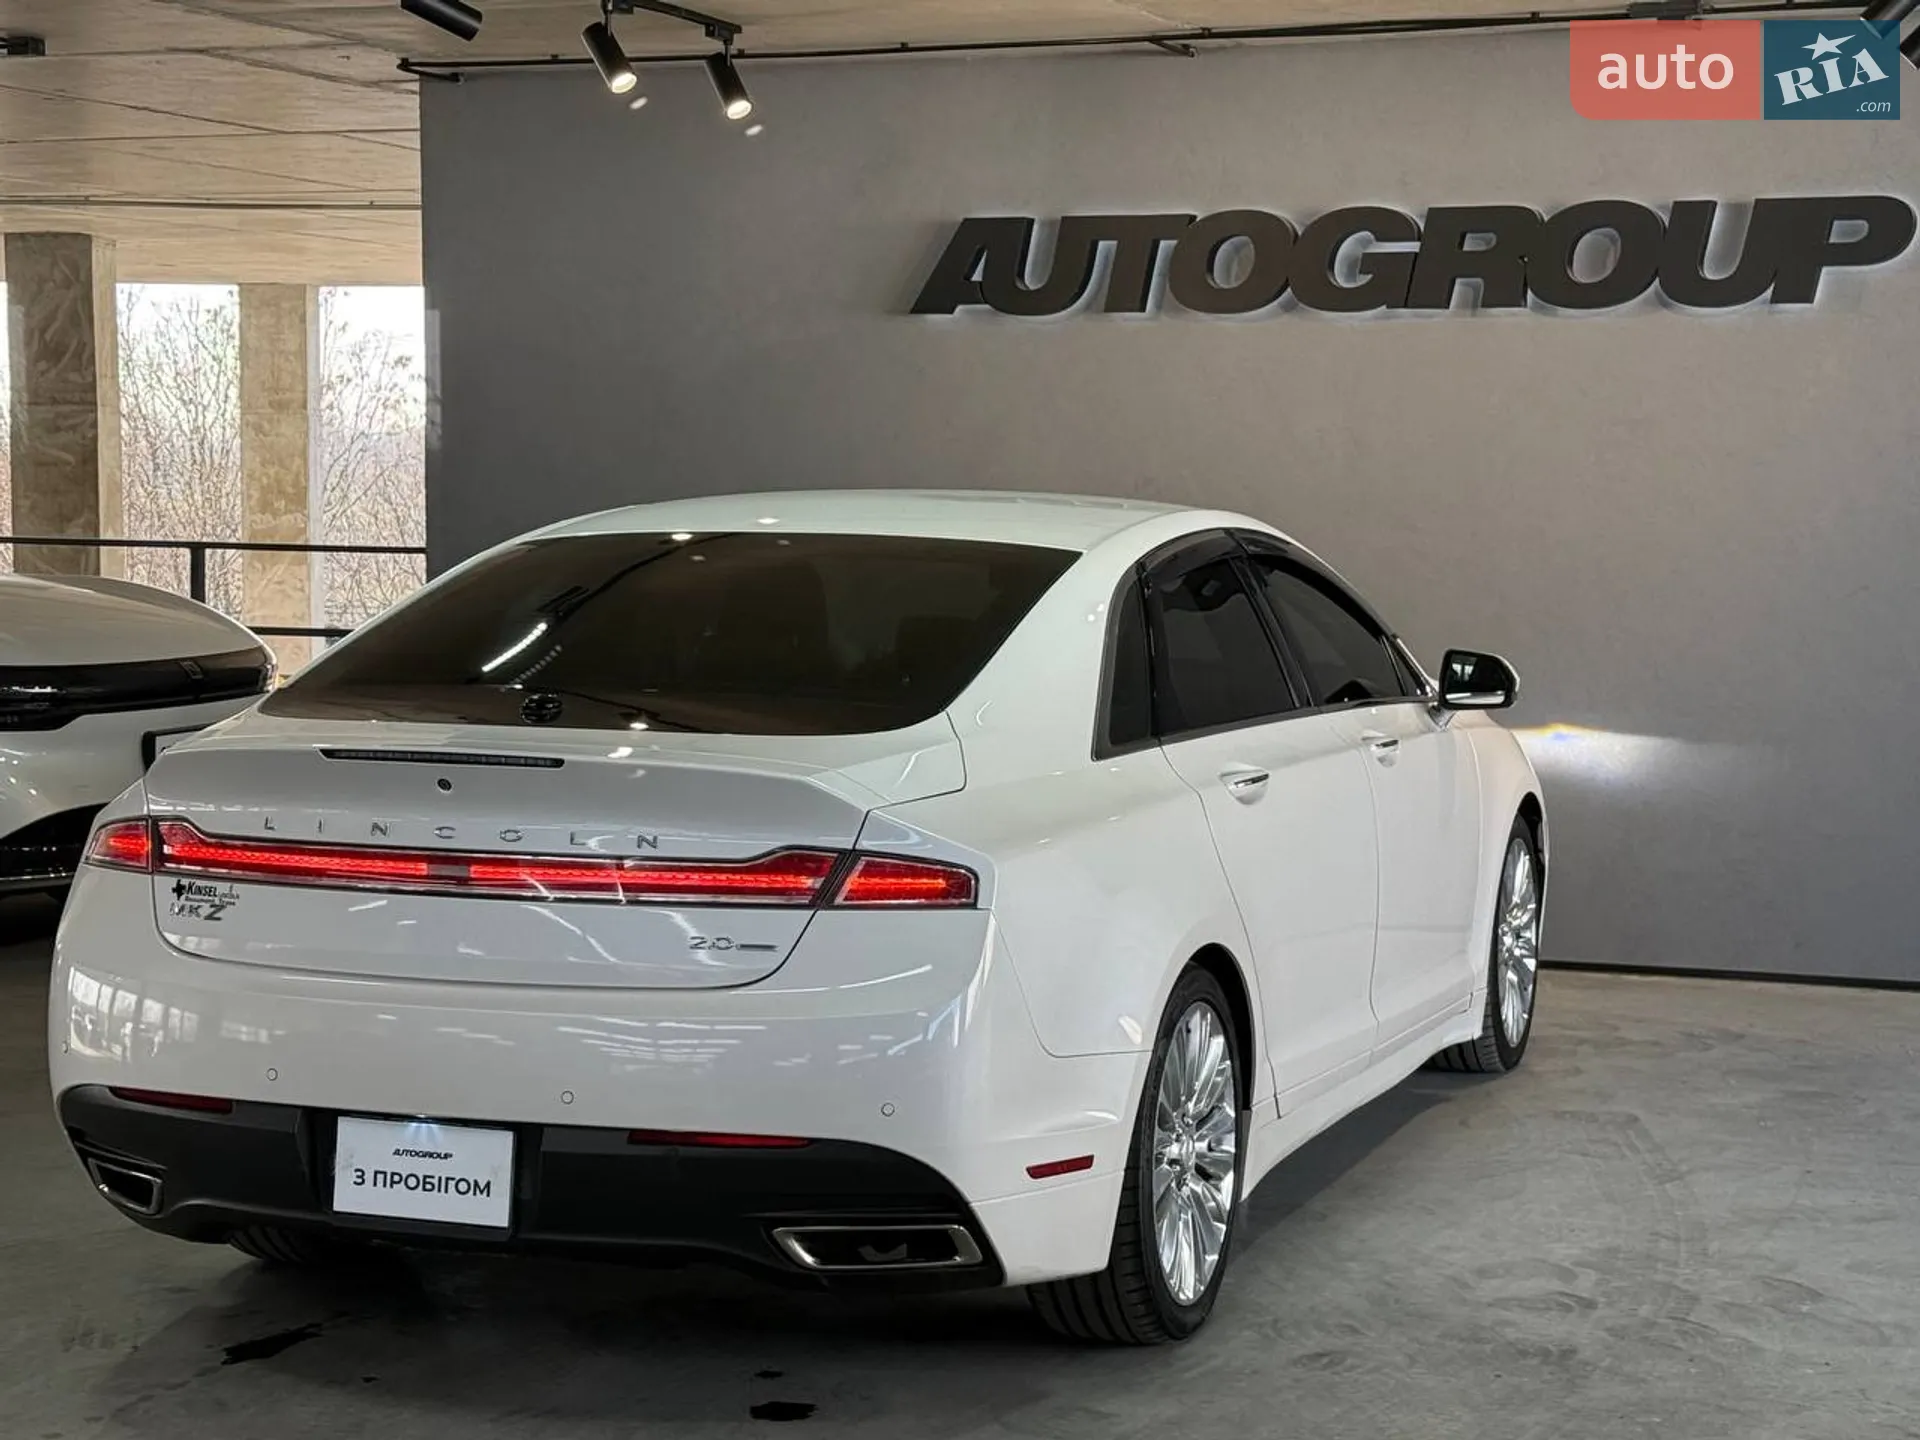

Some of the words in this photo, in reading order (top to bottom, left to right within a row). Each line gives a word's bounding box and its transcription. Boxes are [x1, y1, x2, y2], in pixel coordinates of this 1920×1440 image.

[910, 194, 1918, 315] AUTOGROUP
[263, 816, 659, 850] LINCOLN
[392, 1148, 454, 1161] AUTOGROUP
[353, 1168, 366, 1186] З
[372, 1170, 492, 1198] ПРОБІГОМ
